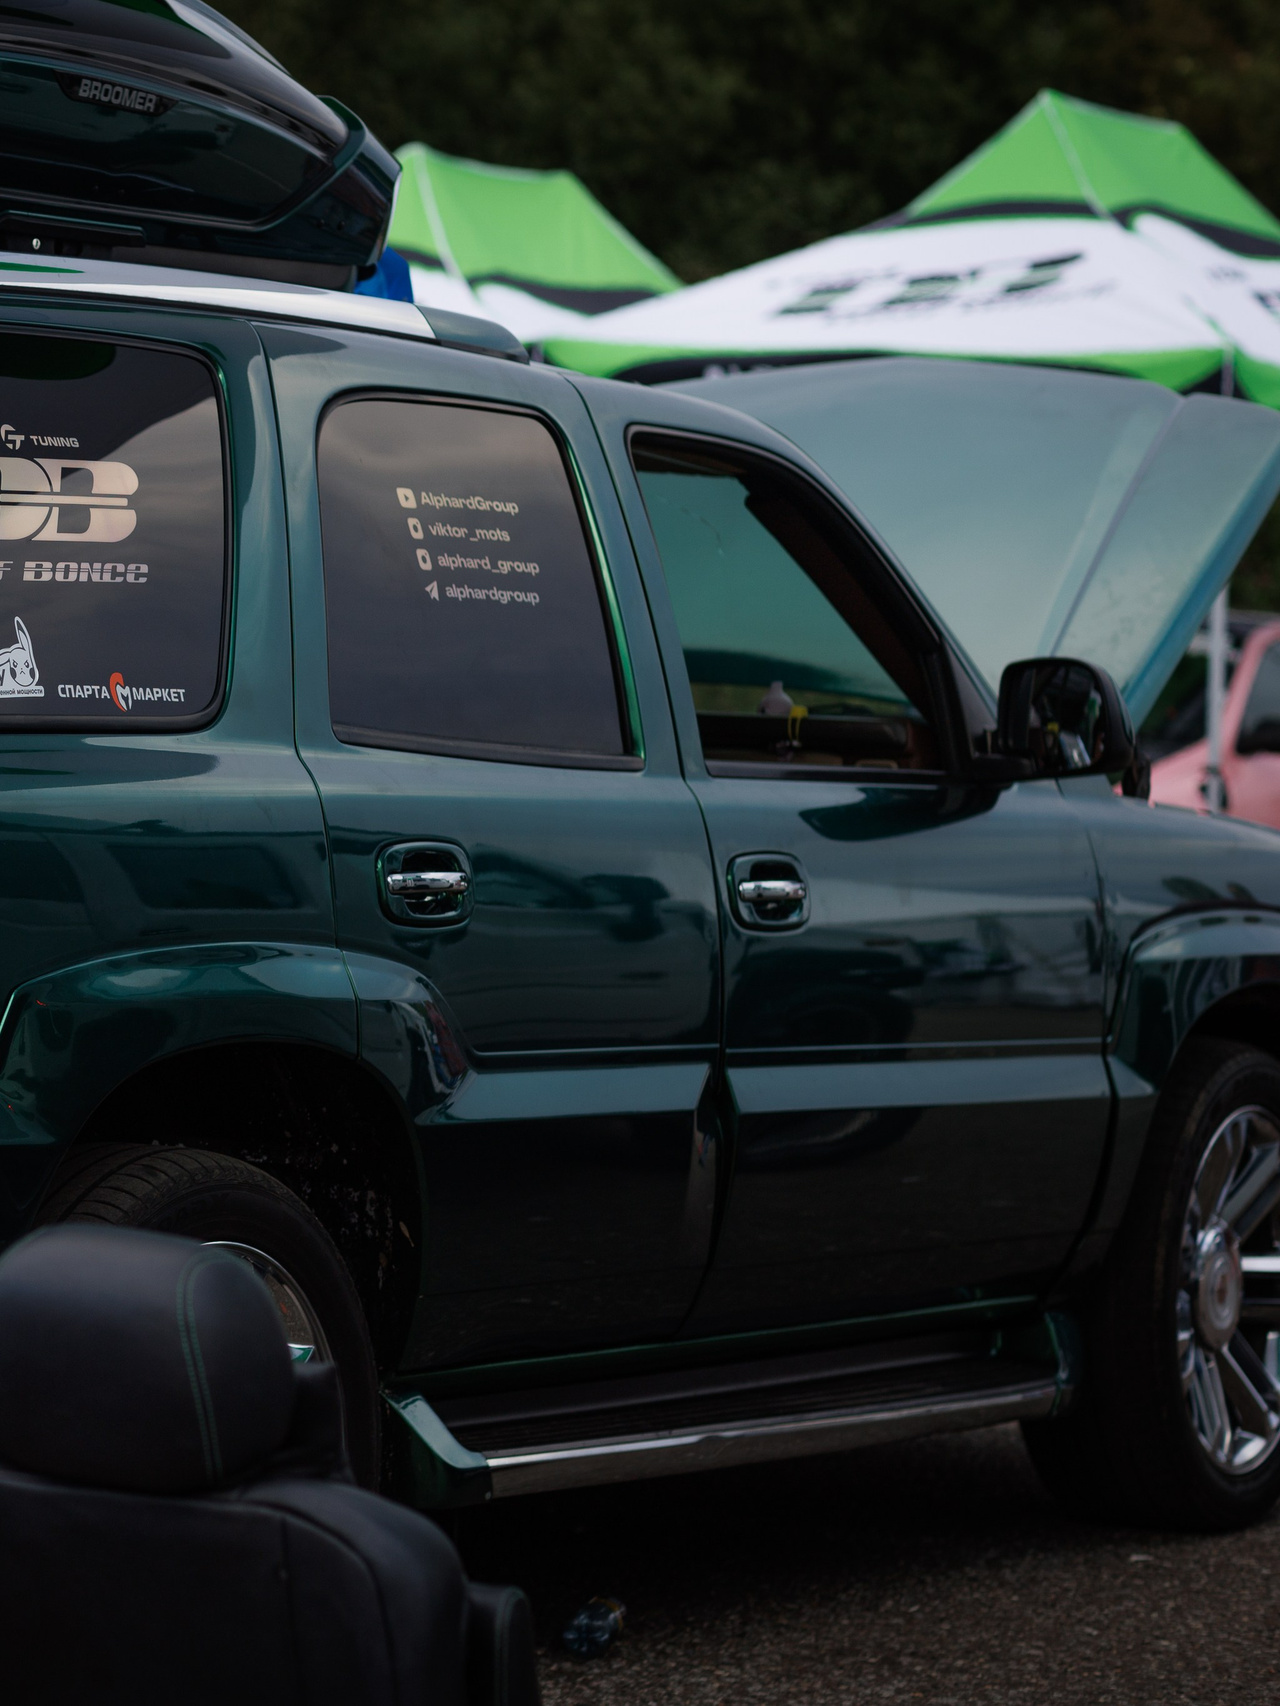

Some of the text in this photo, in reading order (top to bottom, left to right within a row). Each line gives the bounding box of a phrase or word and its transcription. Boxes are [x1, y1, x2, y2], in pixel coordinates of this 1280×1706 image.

[78, 78, 157, 113] BROOMER
[29, 435, 80, 448] TUNING
[421, 491, 518, 514] AlphardGroup
[428, 522, 510, 541] viktor_mots
[437, 552, 538, 575] alphard_group
[445, 583, 538, 605] alphardgroup
[57, 684, 111, 700] СПАРТА
[132, 687, 186, 702] МАРКЕТ
